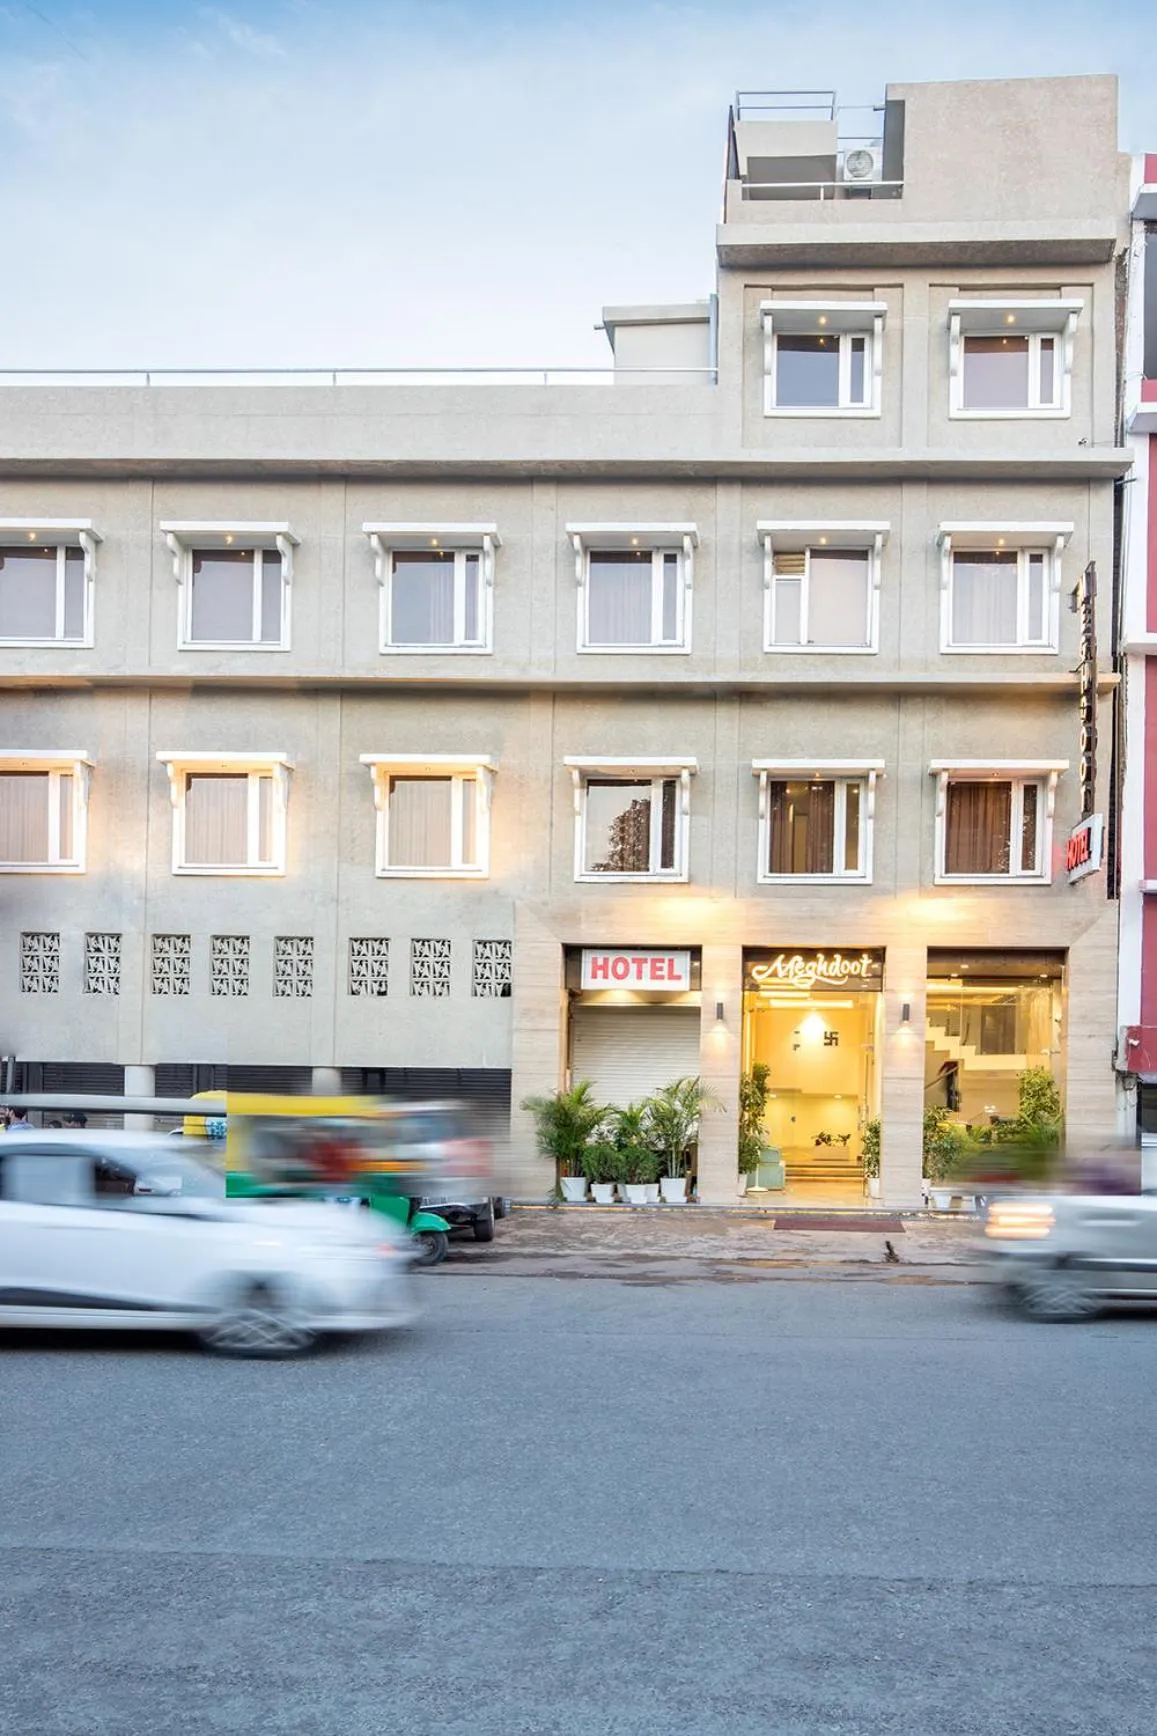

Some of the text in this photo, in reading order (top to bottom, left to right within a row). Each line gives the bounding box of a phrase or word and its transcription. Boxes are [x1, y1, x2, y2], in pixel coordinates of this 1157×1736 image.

[1065, 827, 1091, 872] HOTEL
[591, 956, 682, 981] HOTEL
[752, 953, 872, 987] Meghdoot
